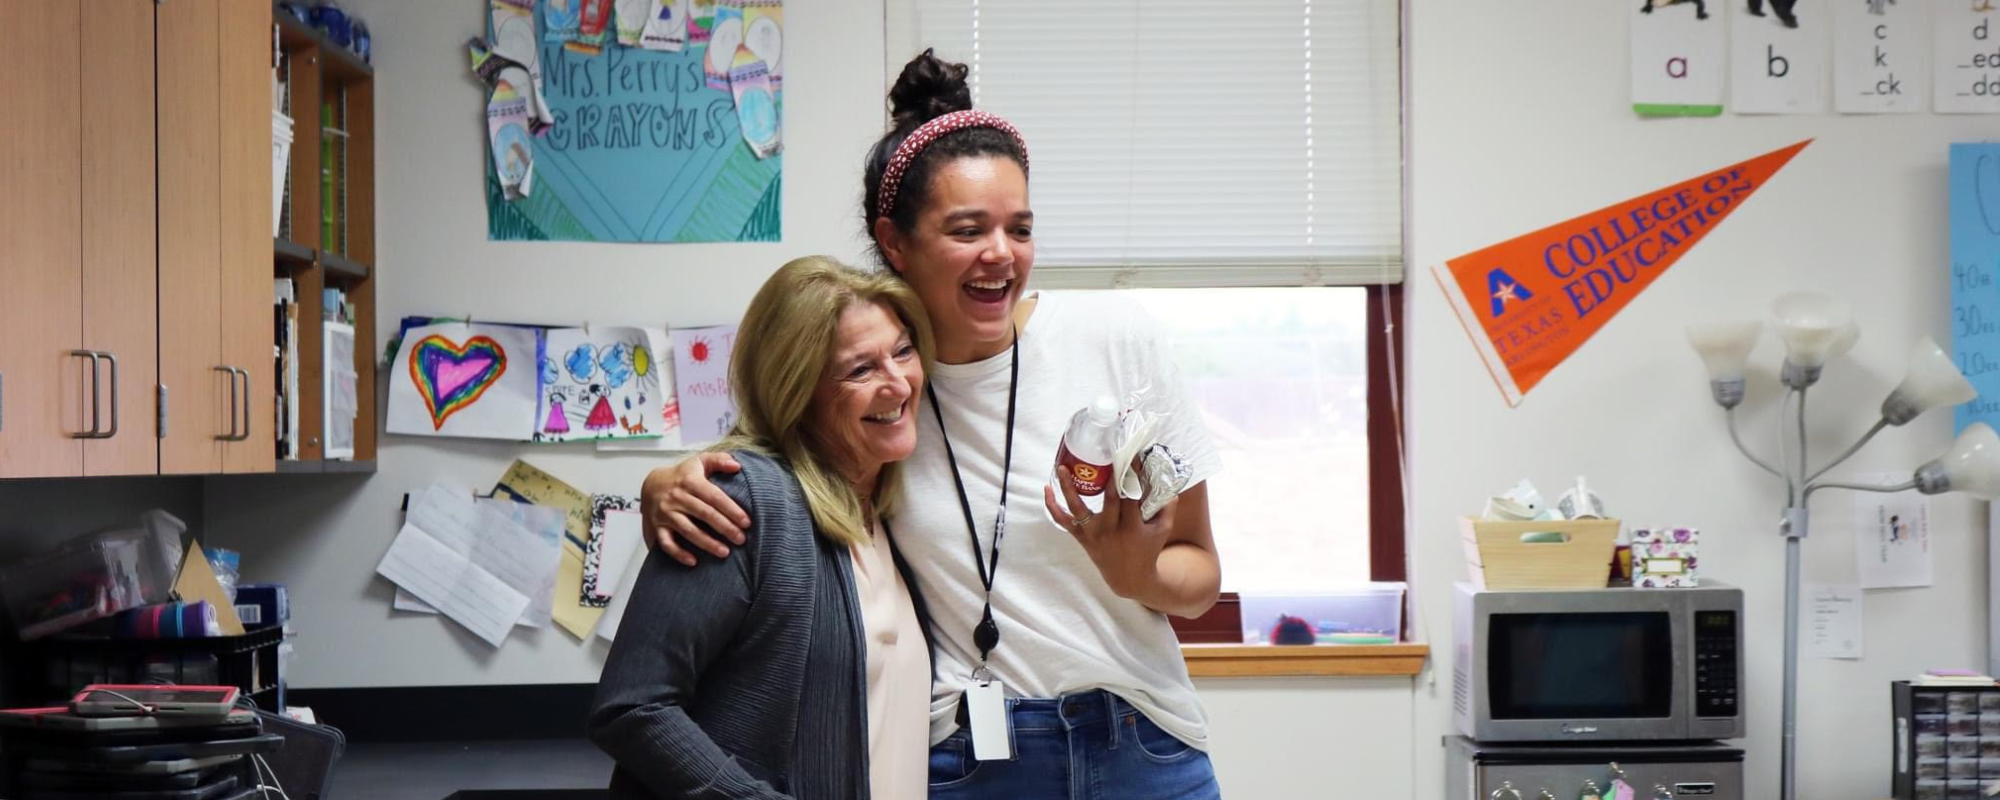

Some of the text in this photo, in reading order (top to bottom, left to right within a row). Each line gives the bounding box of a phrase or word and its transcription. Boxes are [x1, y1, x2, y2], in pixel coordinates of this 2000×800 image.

[1874, 24, 1887, 40] c
[1973, 16, 1988, 41] d
[1665, 56, 1688, 79] a
[1767, 44, 1790, 78] b
[1874, 45, 1887, 67] k
[541, 42, 700, 120] Mrs. Perry's
[545, 98, 736, 151] CRAYONS
[1543, 166, 1746, 279] COLLEGE OF
[1562, 179, 1752, 319] EDUCATION
[1494, 305, 1564, 355] TEXAS
